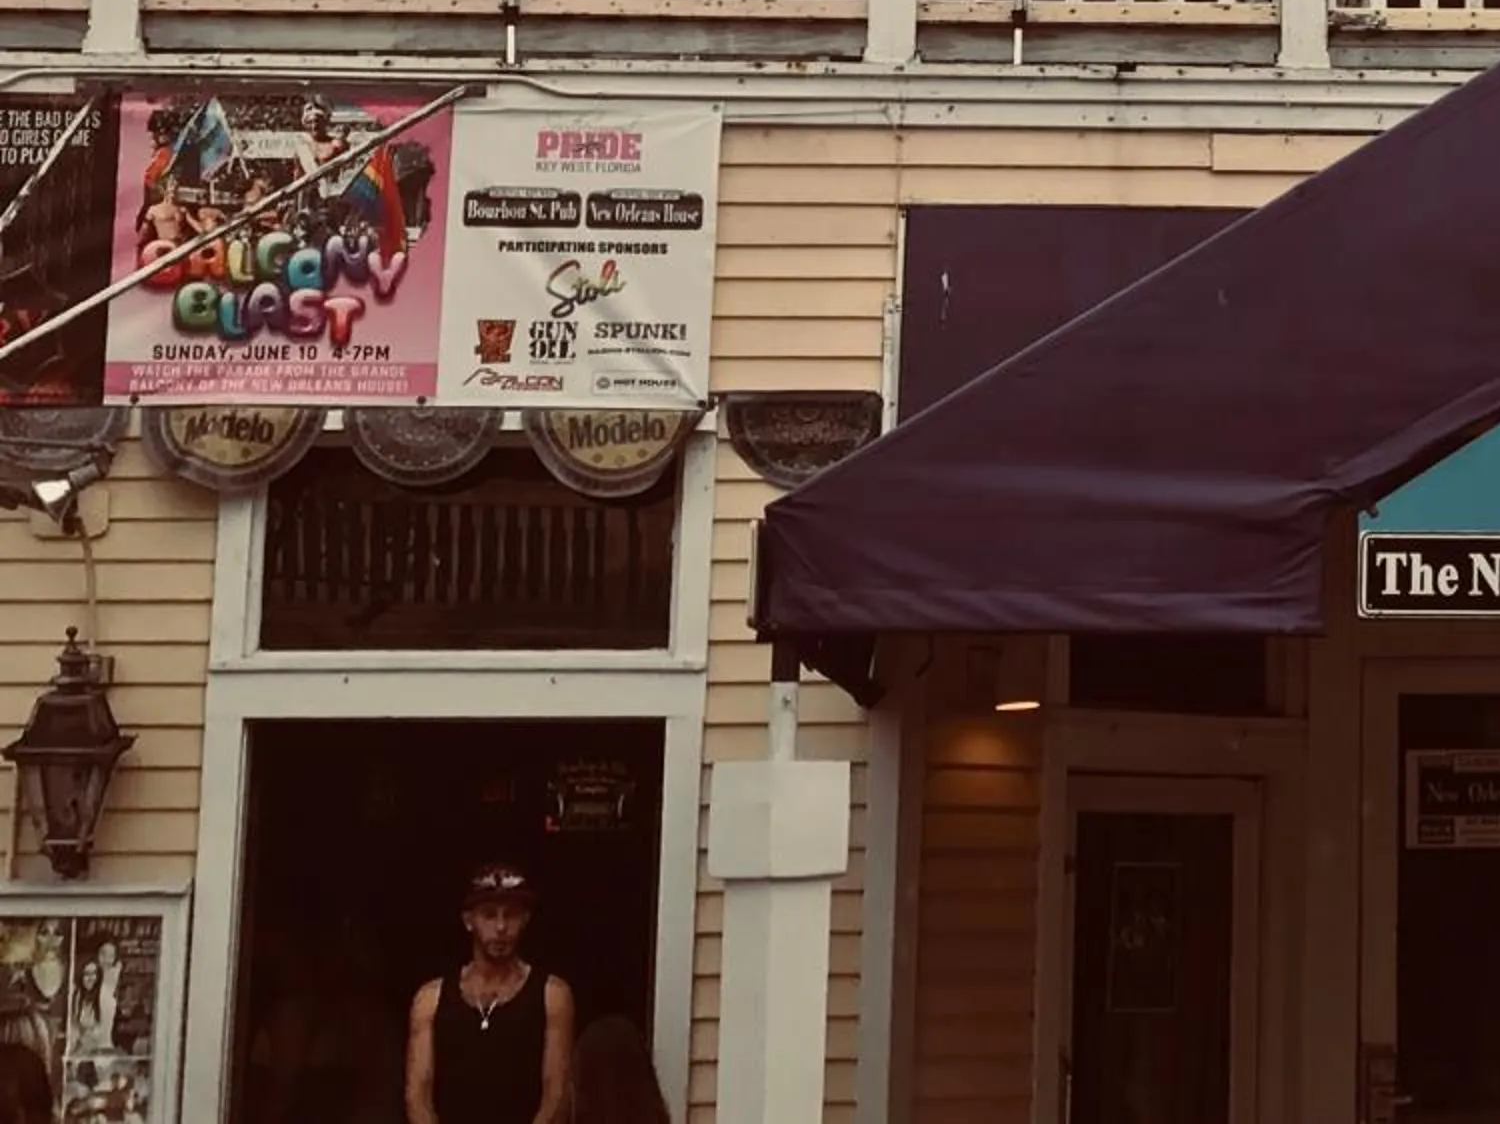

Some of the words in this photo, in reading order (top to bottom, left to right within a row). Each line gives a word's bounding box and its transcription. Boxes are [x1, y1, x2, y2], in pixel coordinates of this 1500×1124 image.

[8, 110, 31, 128] THE
[35, 110, 61, 128] BAD
[65, 111, 101, 129] BS
[12, 129, 50, 146] GIRLS
[53, 129, 91, 146] CME
[536, 130, 643, 160] PRIDE
[1, 147, 18, 165] TO
[535, 161, 557, 172] KEY
[467, 199, 526, 219] Bourbon
[528, 200, 547, 219] St.
[551, 199, 577, 219] Pub
[590, 202, 612, 221] New
[615, 202, 661, 222] Orleans
[663, 202, 699, 223] House
[498, 240, 595, 253] PARTICIPATING
[598, 241, 668, 254] SPONSORS
[545, 260, 627, 318] Stoli
[176, 281, 364, 346] BLAST
[529, 321, 578, 340] GUN
[594, 321, 687, 341] SPUNK!
[152, 345, 234, 362] SUNDAY,
[241, 345, 291, 361] JUNE
[299, 345, 318, 361] 10
[331, 344, 391, 361] 4-7PM
[568, 411, 666, 450] Modelo
[1375, 551, 1459, 596] The
